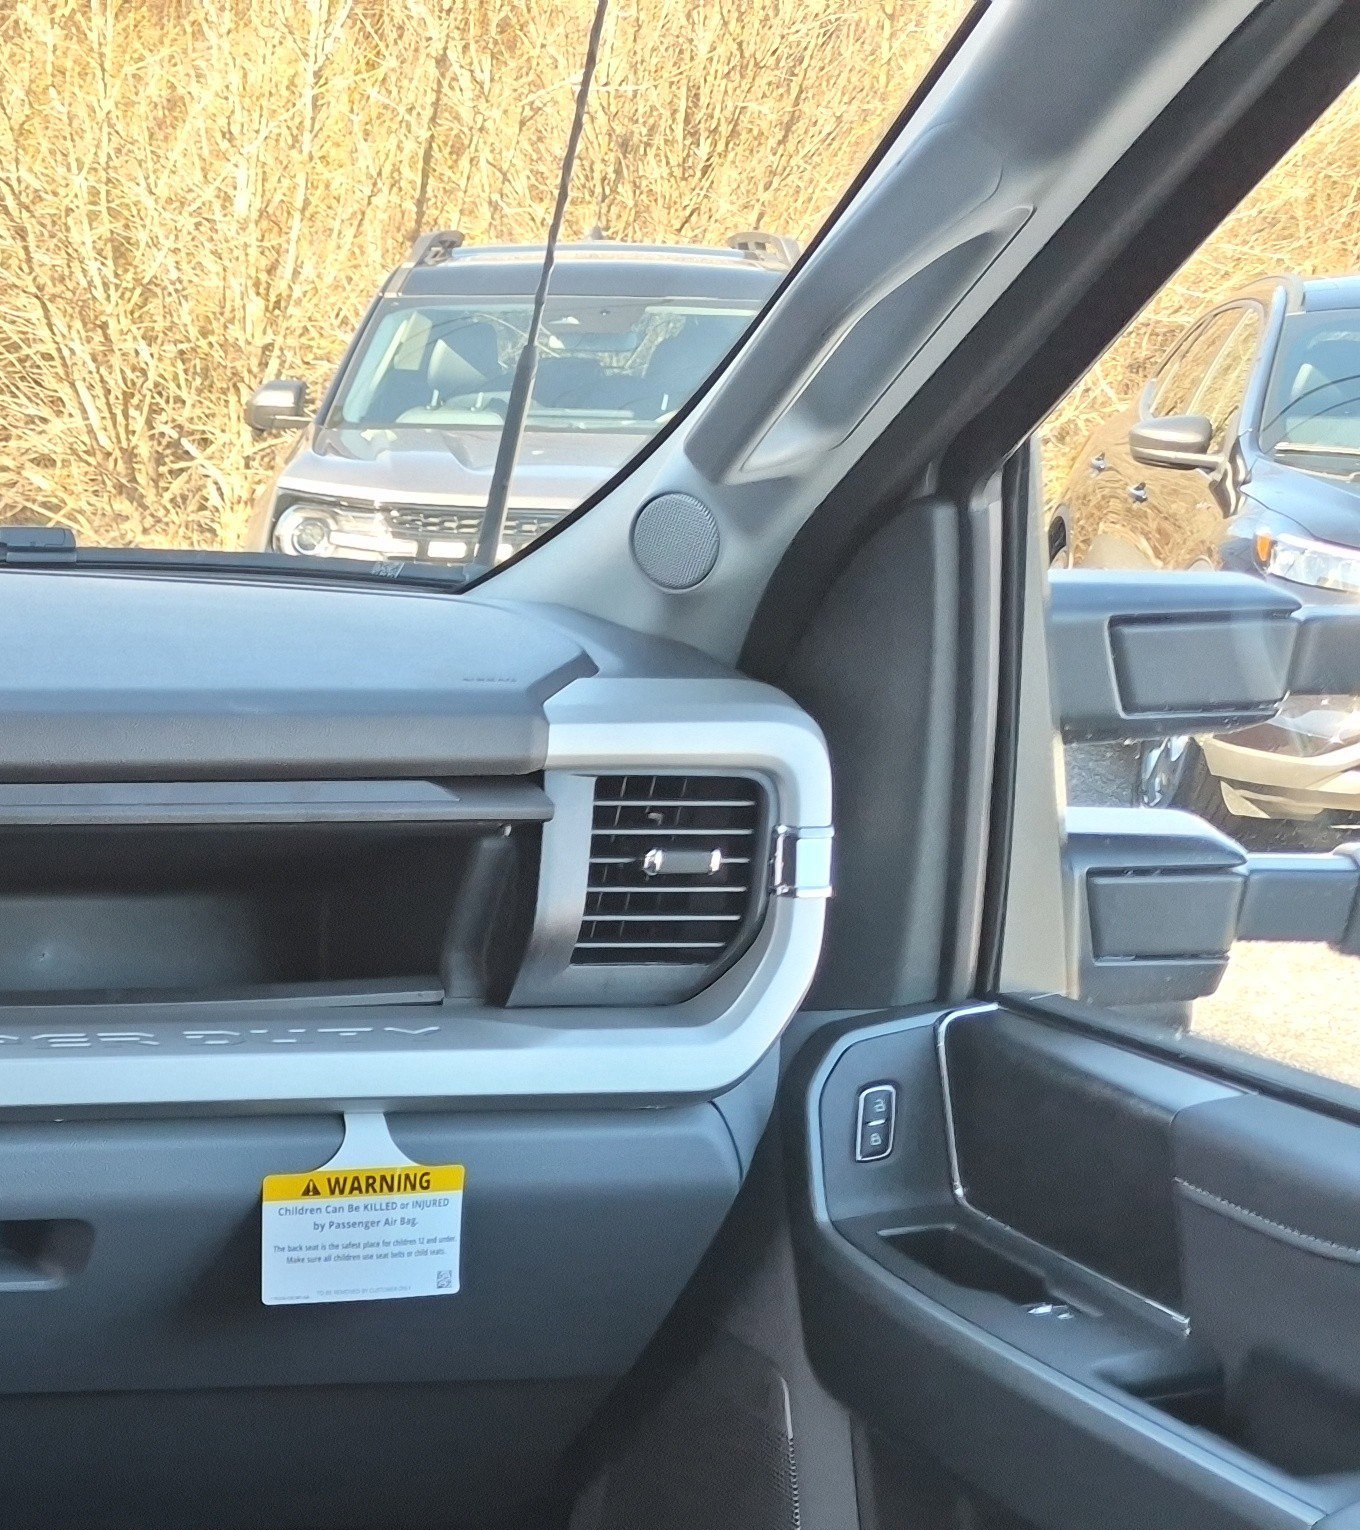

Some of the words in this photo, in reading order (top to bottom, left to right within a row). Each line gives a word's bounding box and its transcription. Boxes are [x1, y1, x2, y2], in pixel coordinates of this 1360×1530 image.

[182, 1026, 441, 1047] DUTY
[327, 1171, 431, 1196] WARNING
[278, 1205, 323, 1217] Children
[325, 1205, 343, 1215] Can
[347, 1204, 361, 1213] Be
[363, 1202, 398, 1211] KILLED
[400, 1202, 410, 1210] or
[411, 1198, 450, 1211] INJURED
[313, 1220, 326, 1233] by
[328, 1218, 382, 1232] Passenger
[383, 1217, 397, 1226] Air
[273, 1245, 285, 1253] The
[287, 1244, 303, 1252] back
[305, 1244, 319, 1252] seat
[328, 1243, 339, 1251] the
[341, 1241, 361, 1250] safest
[362, 1240, 380, 1250] place
[393, 1238, 417, 1247] children
[426, 1236, 438, 1244] and
[285, 1256, 305, 1265] Make
[307, 1256, 322, 1264] sure
[323, 1254, 332, 1263] all
[333, 1253, 361, 1262] children
[414, 1249, 429, 1257] child
